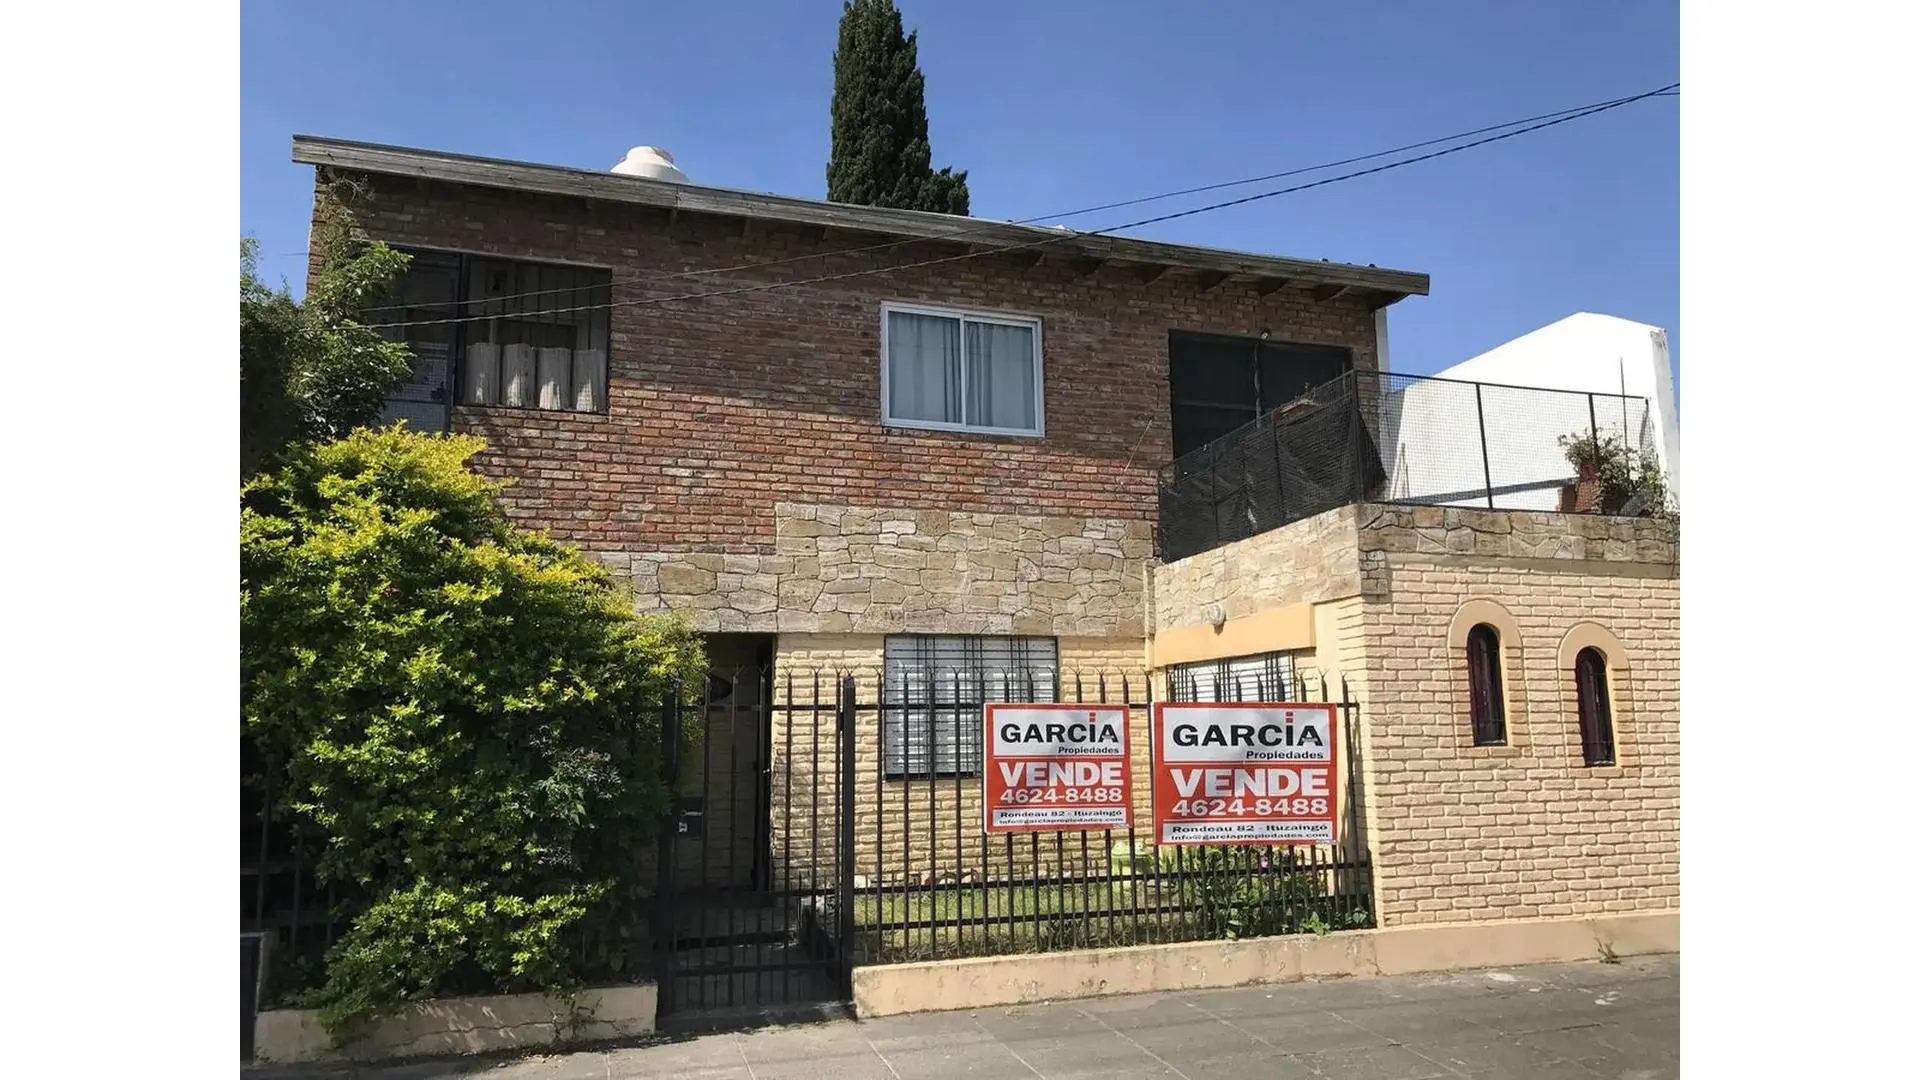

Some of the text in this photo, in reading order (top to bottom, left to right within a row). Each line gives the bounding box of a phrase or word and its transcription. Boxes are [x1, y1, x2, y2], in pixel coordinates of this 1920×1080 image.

[1058, 746, 1120, 755] Propiedades
[1246, 751, 1324, 760] Propiedades
[999, 761, 1124, 787] VENDE
[1170, 768, 1330, 798] VENDE
[1000, 787, 1123, 804] 4624-8488
[1171, 798, 1329, 817] 4624-8488
[1172, 825, 1233, 833] Rondeau
[1266, 824, 1329, 833] Ituzaingó
